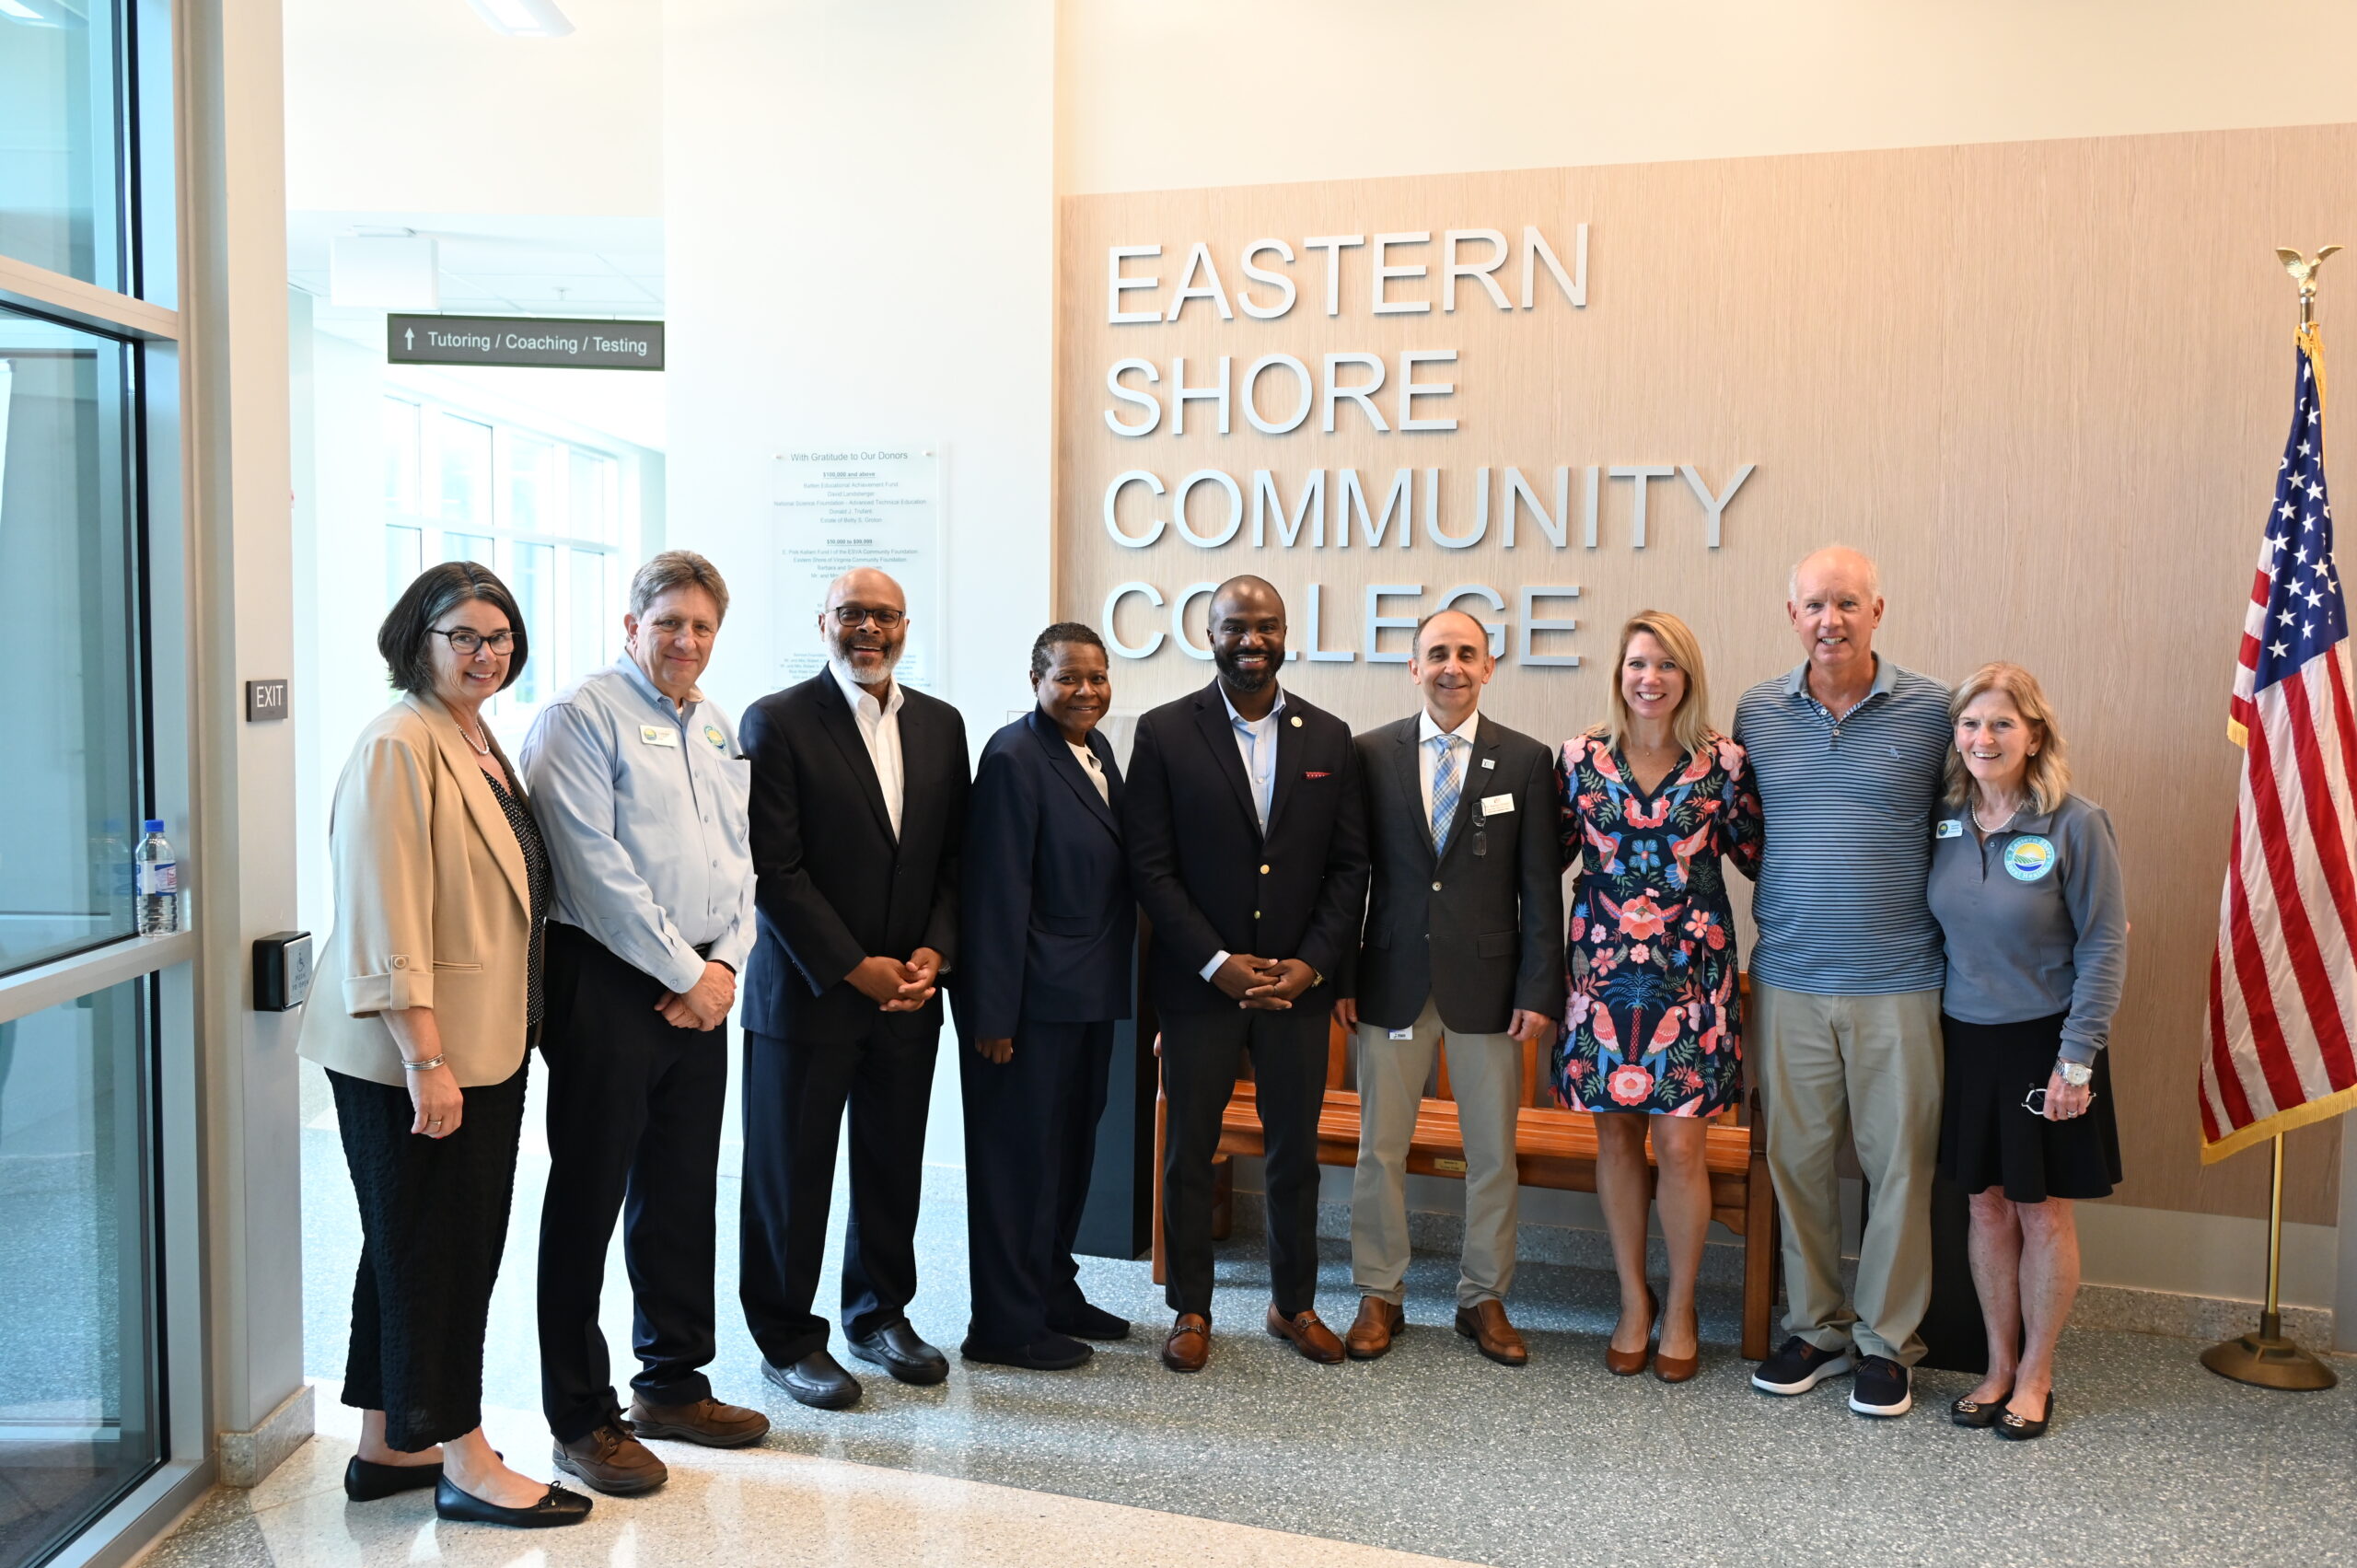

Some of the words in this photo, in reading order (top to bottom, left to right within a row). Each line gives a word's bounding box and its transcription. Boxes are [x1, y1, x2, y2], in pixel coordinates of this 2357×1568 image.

[1108, 223, 1588, 324] EASTERN
[428, 331, 490, 352] Tutoring
[505, 333, 578, 354] Coaching
[593, 336, 647, 356] Testing
[1104, 349, 1459, 436] SHORE
[790, 452, 808, 461] With
[811, 452, 848, 461] Gratitude
[851, 452, 858, 460] to
[861, 451, 876, 460] Our
[878, 451, 908, 460] Donors
[1103, 463, 1757, 549] COMMUNITY
[1101, 581, 1581, 668] COLEGE
[257, 685, 284, 708] EXIT
